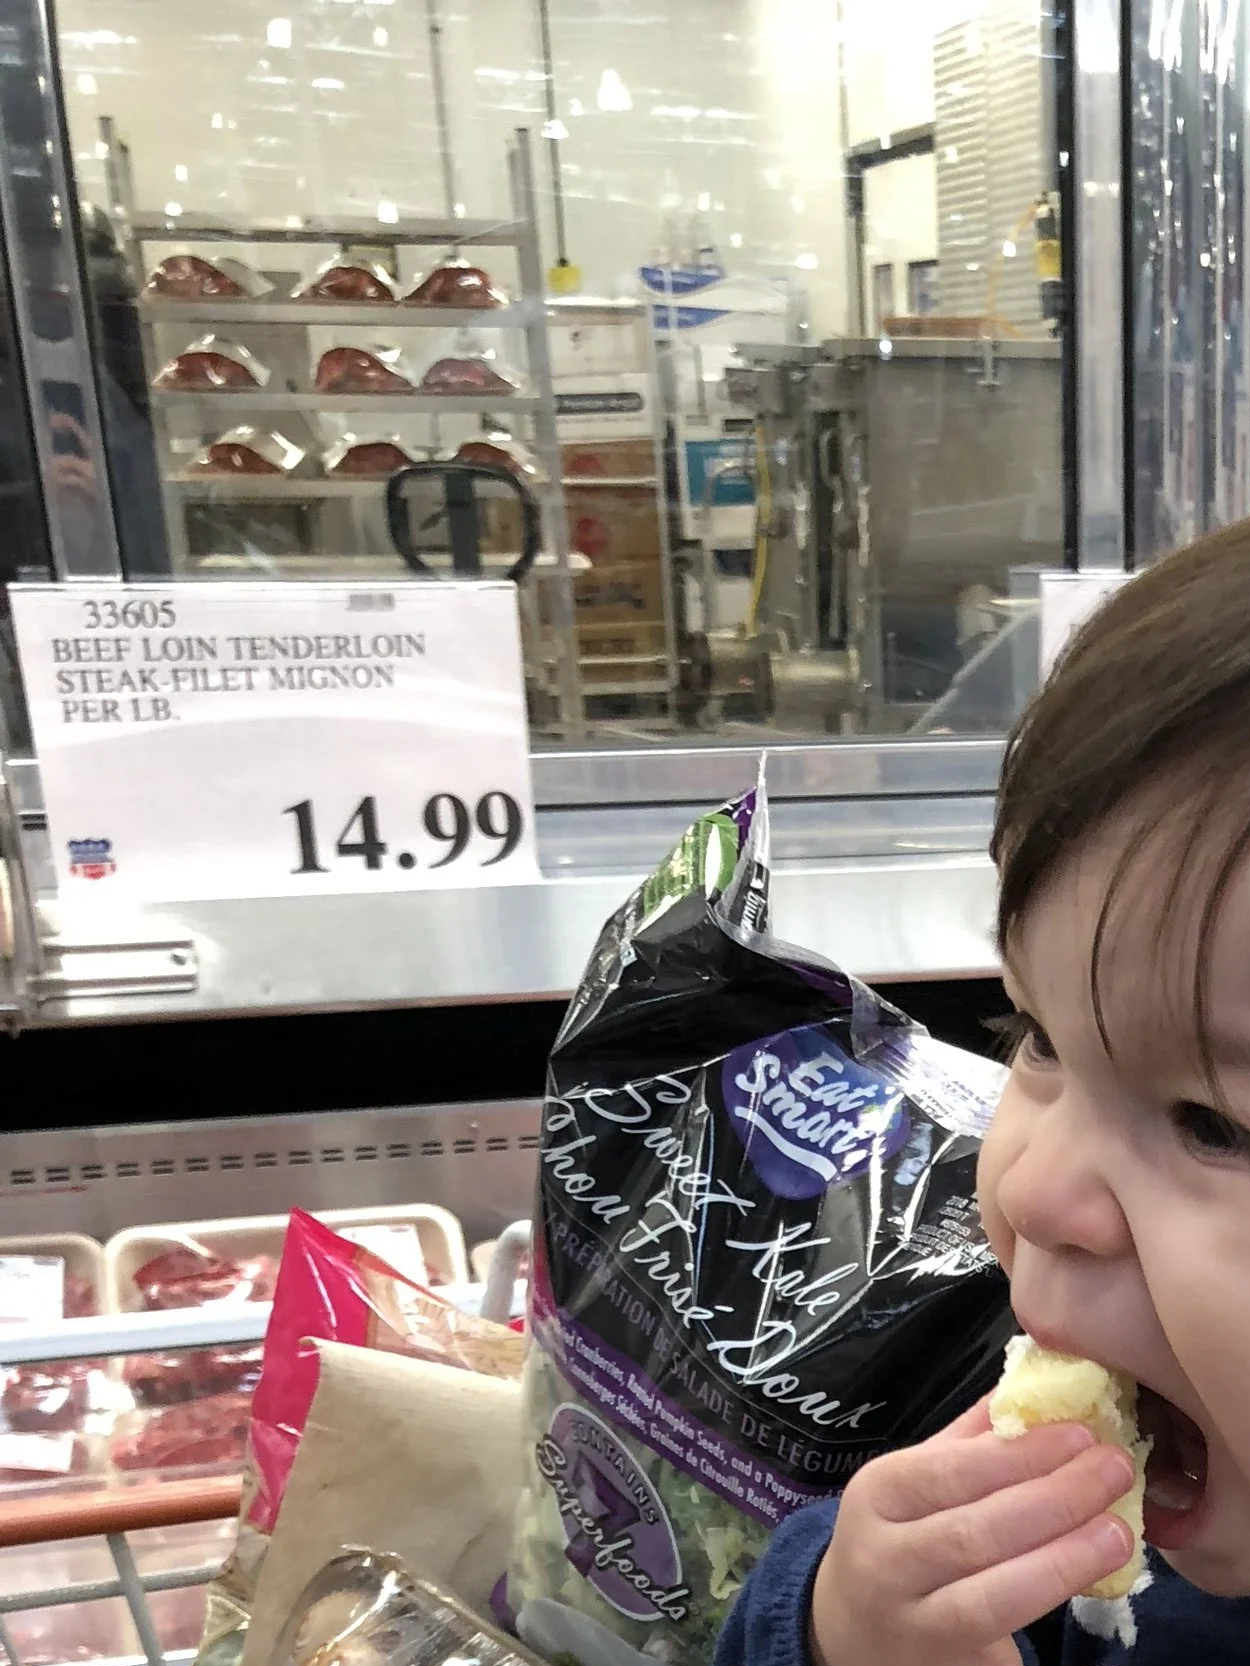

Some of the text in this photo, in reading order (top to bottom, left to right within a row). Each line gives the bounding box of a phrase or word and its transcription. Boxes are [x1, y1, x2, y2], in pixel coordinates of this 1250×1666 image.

[52, 633, 427, 662] BEEF LOIN TENDERLOIN
[83, 600, 177, 629] 33605
[56, 664, 395, 694] STEAK-FILET MIGNON
[62, 697, 181, 723] PER LB.
[280, 790, 524, 875] 14.99
[734, 1053, 878, 1155] Smart
[787, 1051, 880, 1114] Eat
[585, 1074, 859, 1316] Sweet Kale
[540, 1095, 887, 1429] Chou Frisé Doux
[655, 1399, 695, 1441] Pumpkin
[697, 1429, 728, 1466] Seeds,
[731, 1455, 753, 1477] and
[754, 1470, 762, 1484] a
[668, 1351, 735, 1425] SALADE
[740, 1413, 773, 1448] DE
[571, 1420, 661, 1525] CONTAINS
[685, 1447, 698, 1468] de
[699, 1457, 745, 1499] Citrouille
[536, 1438, 689, 1621] Superfoods
